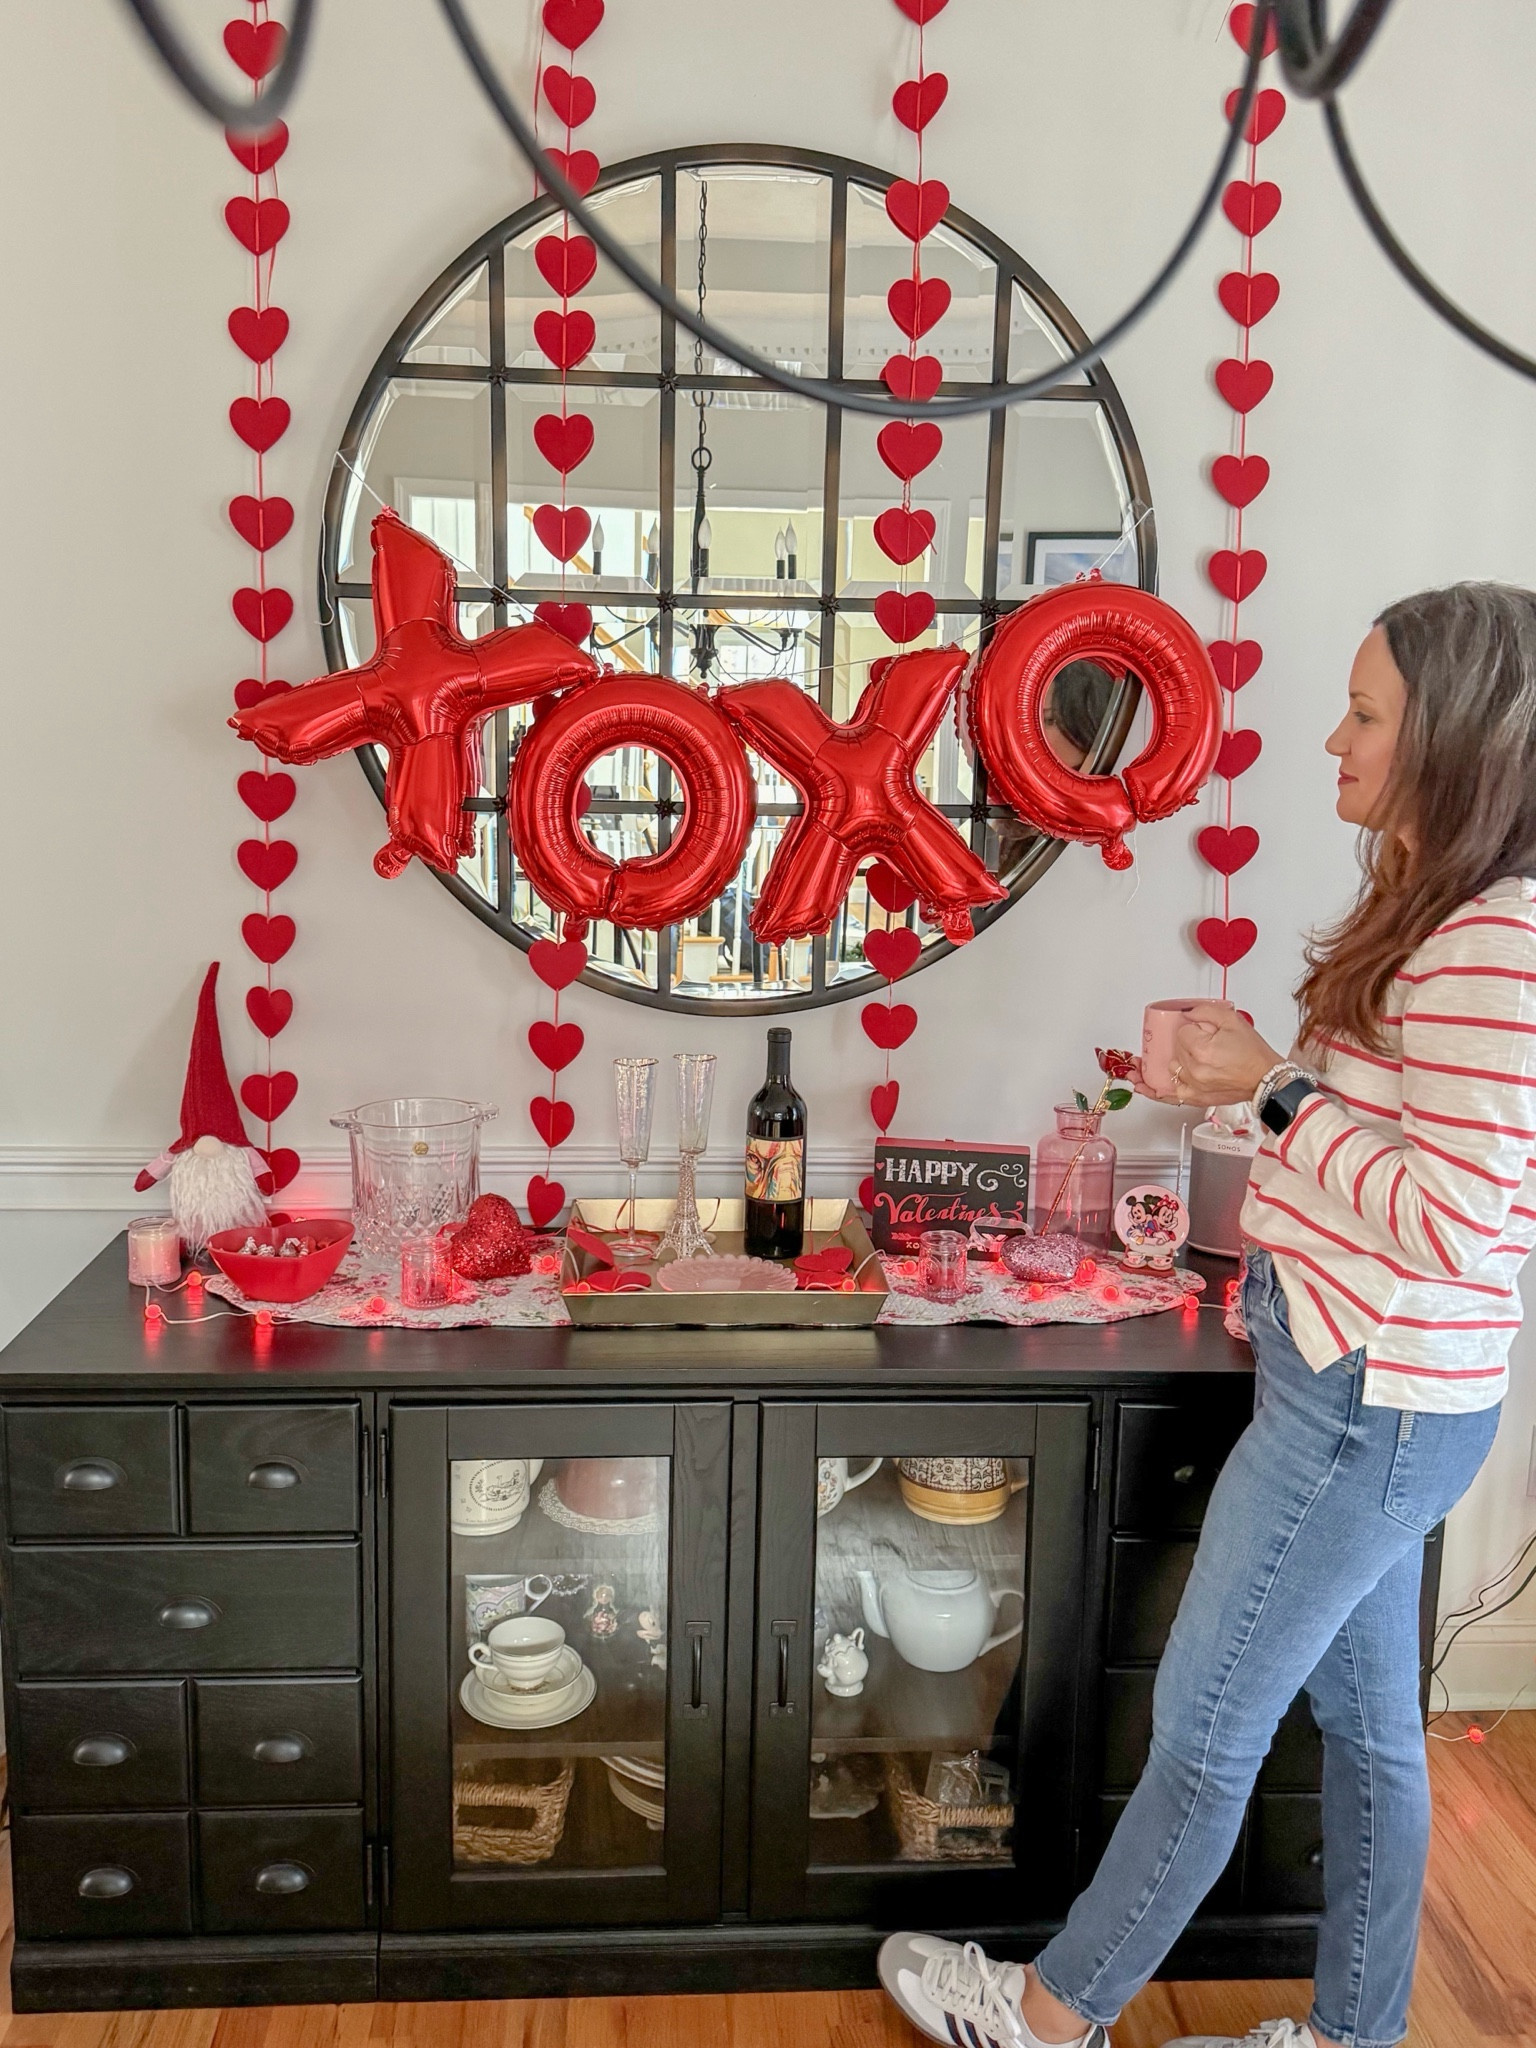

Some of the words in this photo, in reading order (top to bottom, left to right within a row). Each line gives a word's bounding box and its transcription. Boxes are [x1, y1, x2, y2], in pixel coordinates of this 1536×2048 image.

[227, 506, 1224, 945] XOXO
[1217, 1143, 1241, 1152] SONOS
[884, 1157, 978, 1187] HAPPY
